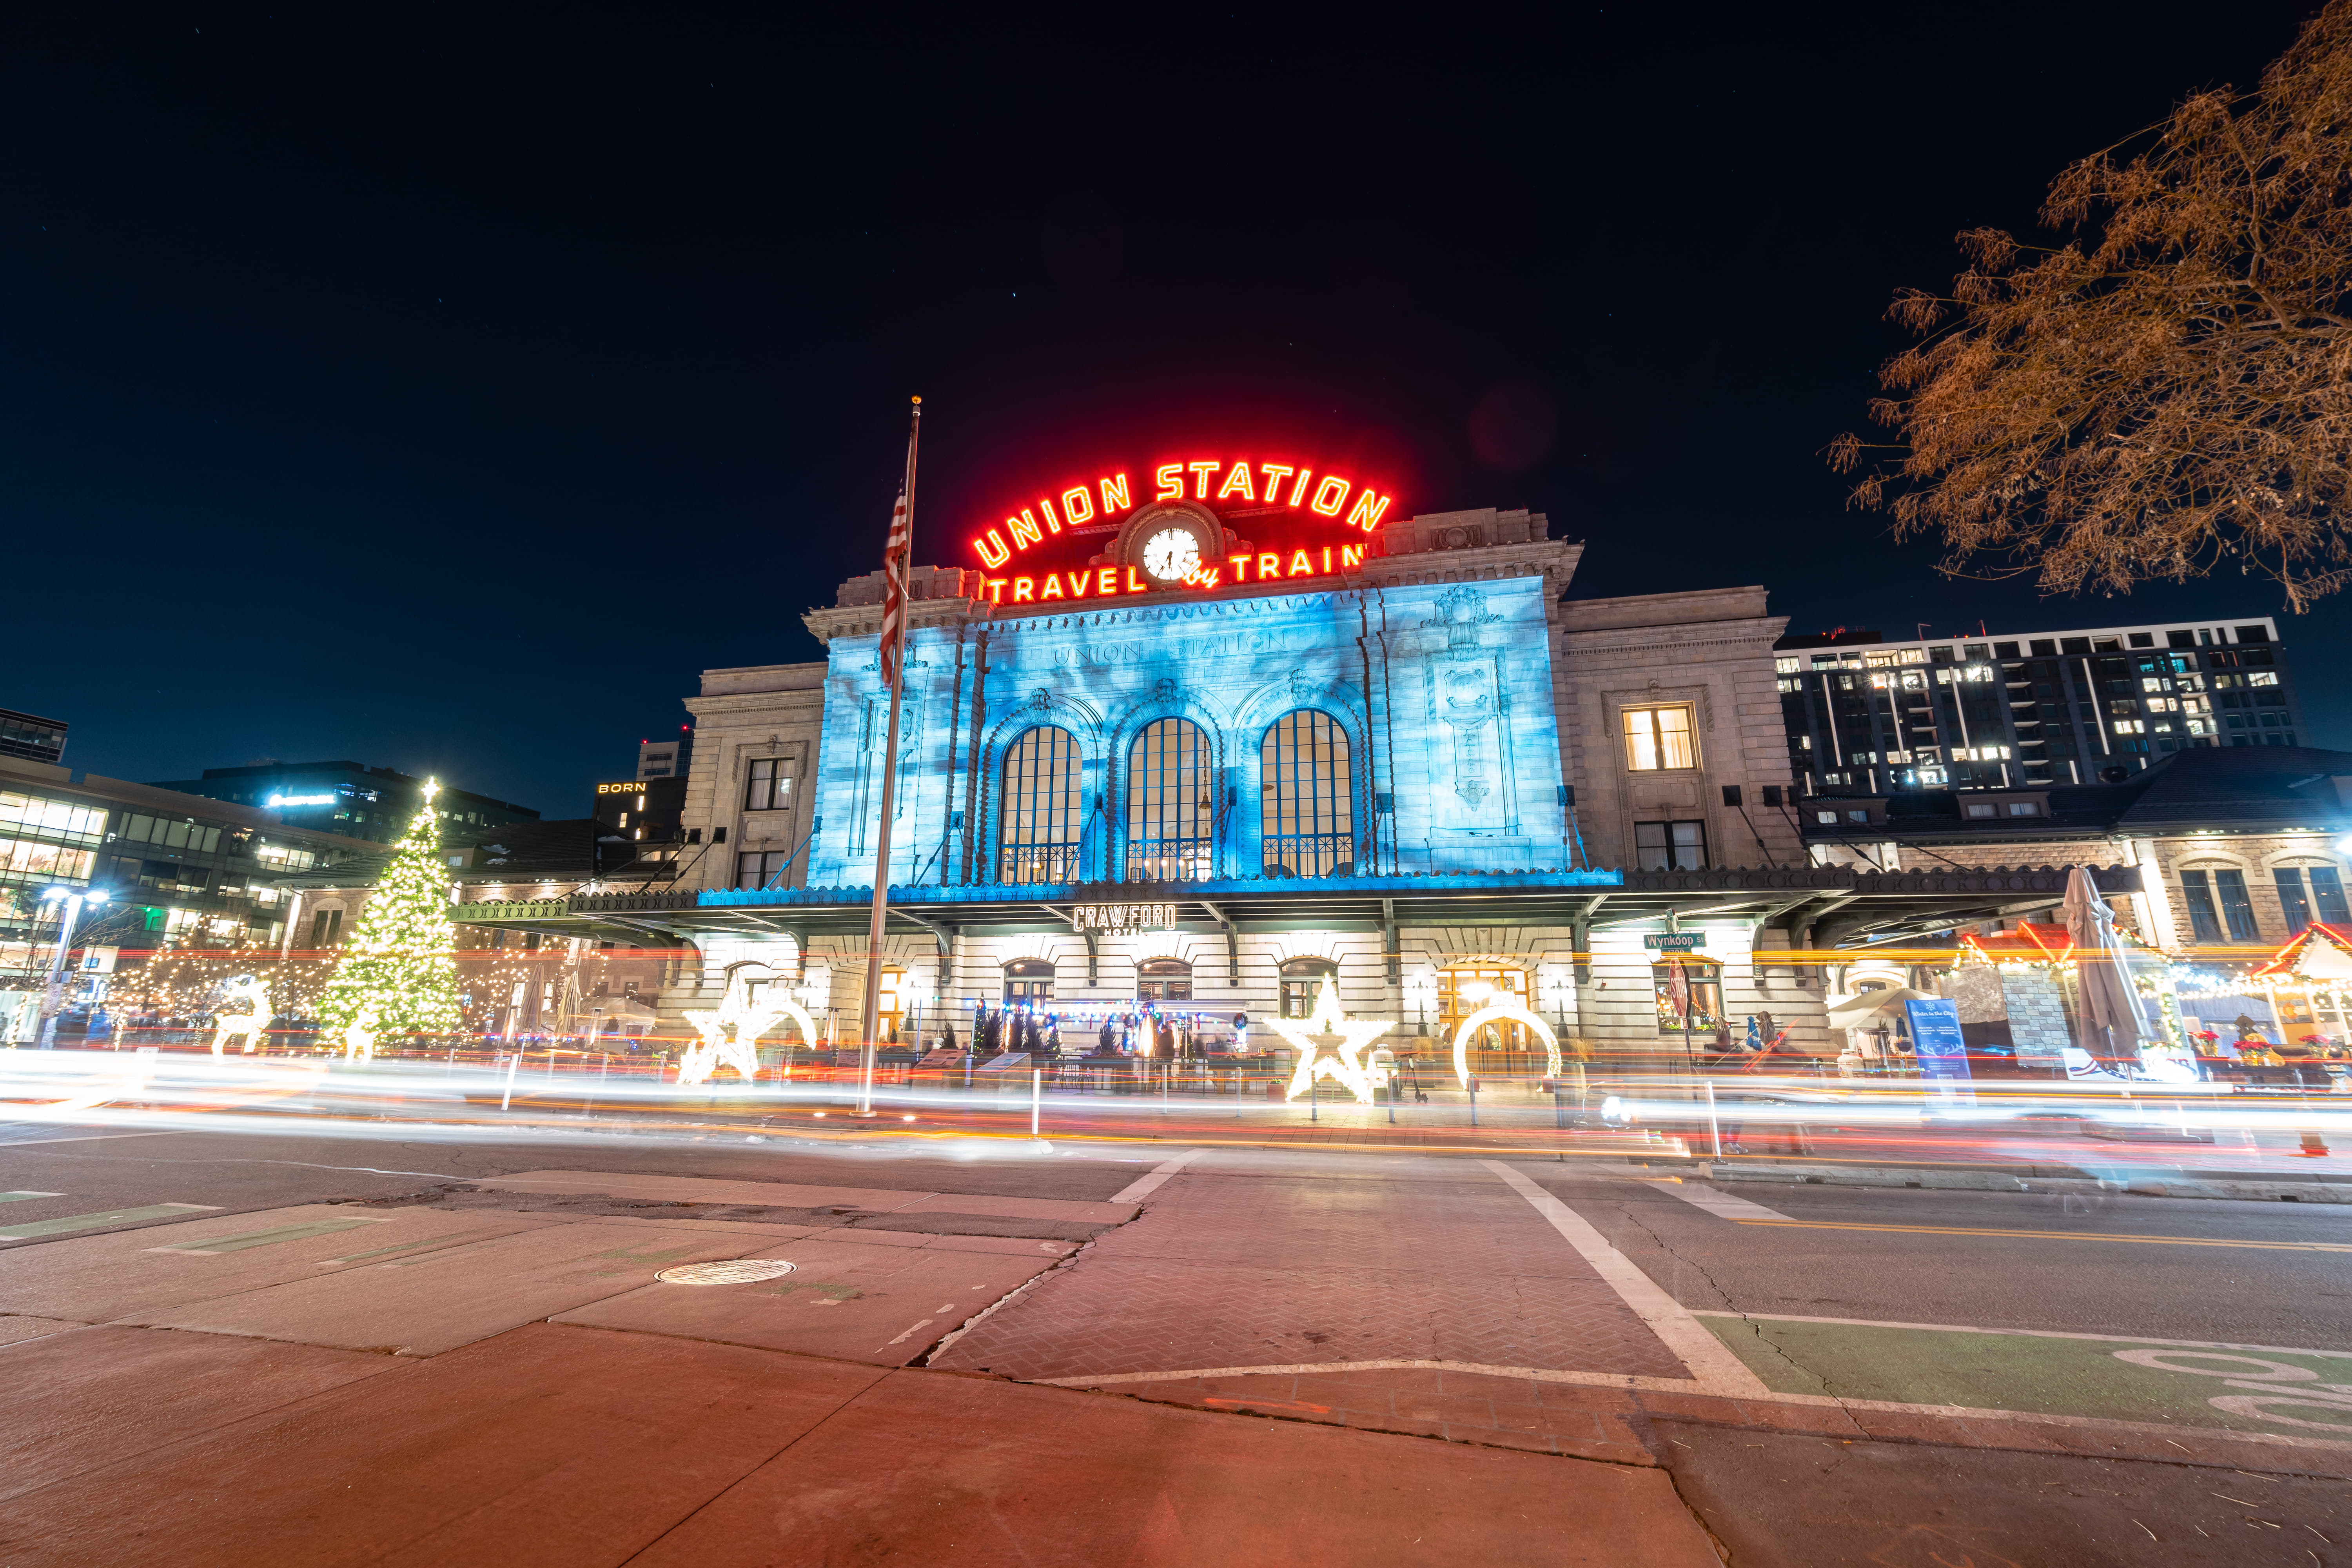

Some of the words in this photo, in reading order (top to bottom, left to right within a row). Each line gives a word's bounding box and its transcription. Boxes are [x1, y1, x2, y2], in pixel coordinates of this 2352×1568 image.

[974, 474, 1131, 568] UNION
[1156, 461, 1390, 532] STATION
[987, 566, 1146, 604] TRAVEL
[1181, 559, 1219, 588] by
[1229, 543, 1364, 581] TRAIN
[1054, 642, 1143, 665] UNION
[1170, 631, 1288, 657] STATION
[599, 783, 646, 793] BORN
[1073, 905, 1176, 932] CRAWFORD
[1104, 928, 1145, 936] HOTEL
[1647, 935, 1693, 947] Wynkoop
[1671, 977, 1686, 998] STOP
